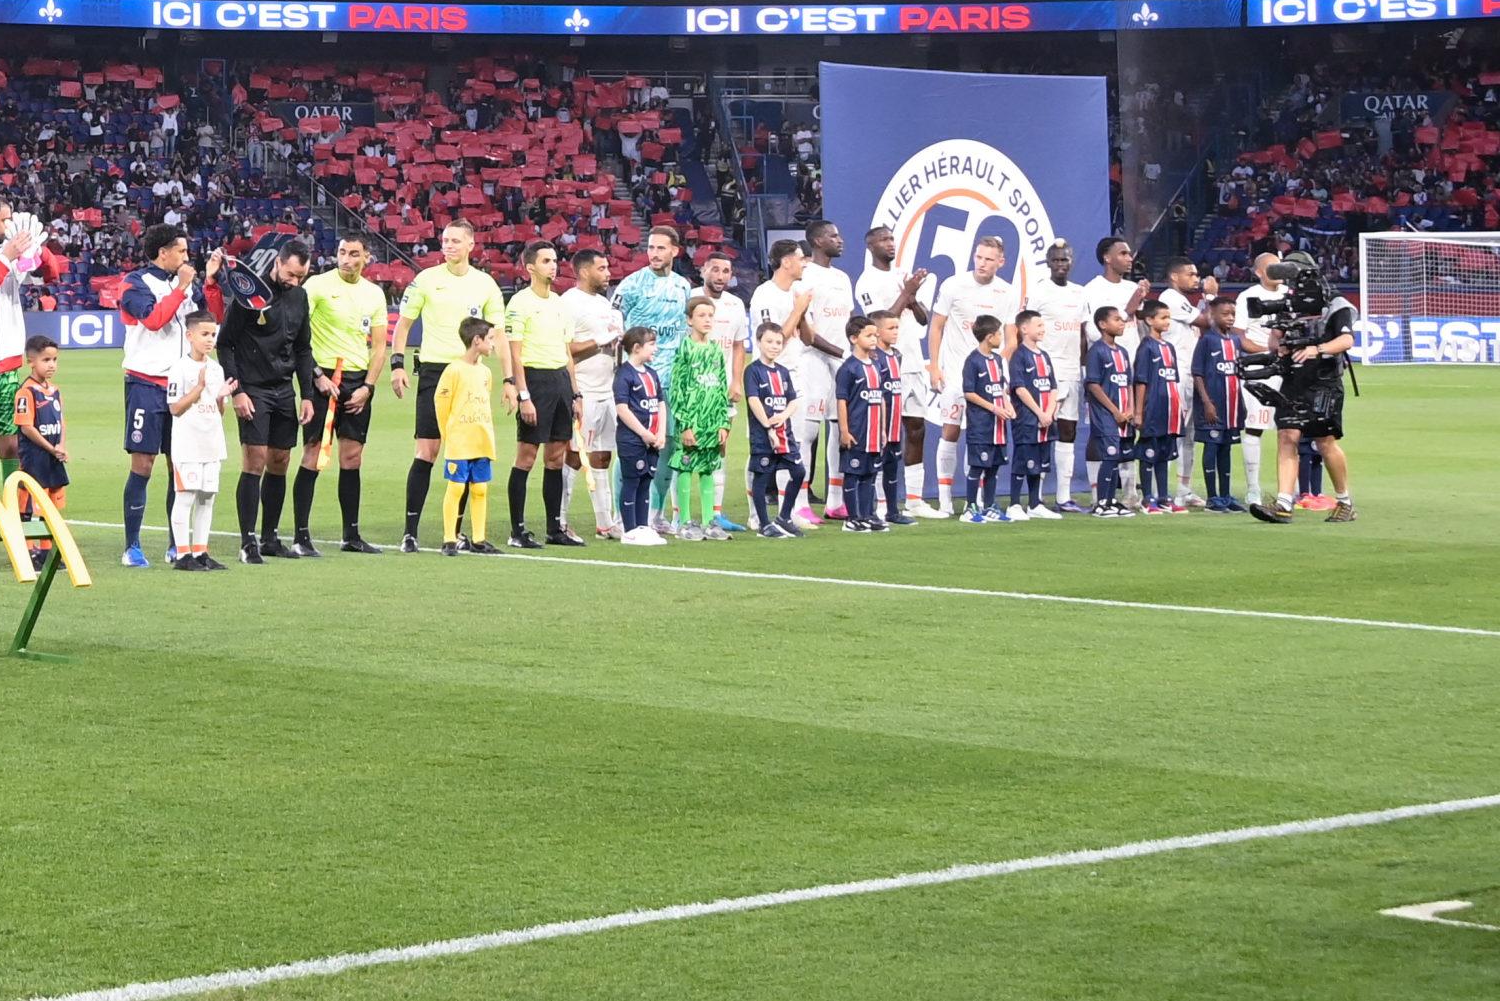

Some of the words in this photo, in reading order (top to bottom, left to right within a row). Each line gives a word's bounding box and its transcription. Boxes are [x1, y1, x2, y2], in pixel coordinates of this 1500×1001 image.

[153, 1, 200, 26] ICI
[216, 2, 336, 28] C'EST
[349, 4, 468, 31] PARIS
[686, 7, 739, 33] ICI
[756, 7, 886, 32] C'EST
[900, 5, 1031, 30] PARIS
[1364, 94, 1428, 114] QATAR
[924, 151, 1010, 191] HÉRAULT
[61, 314, 113, 345] ICI
[133, 408, 145, 429] 5
[1258, 409, 1269, 424] 10
